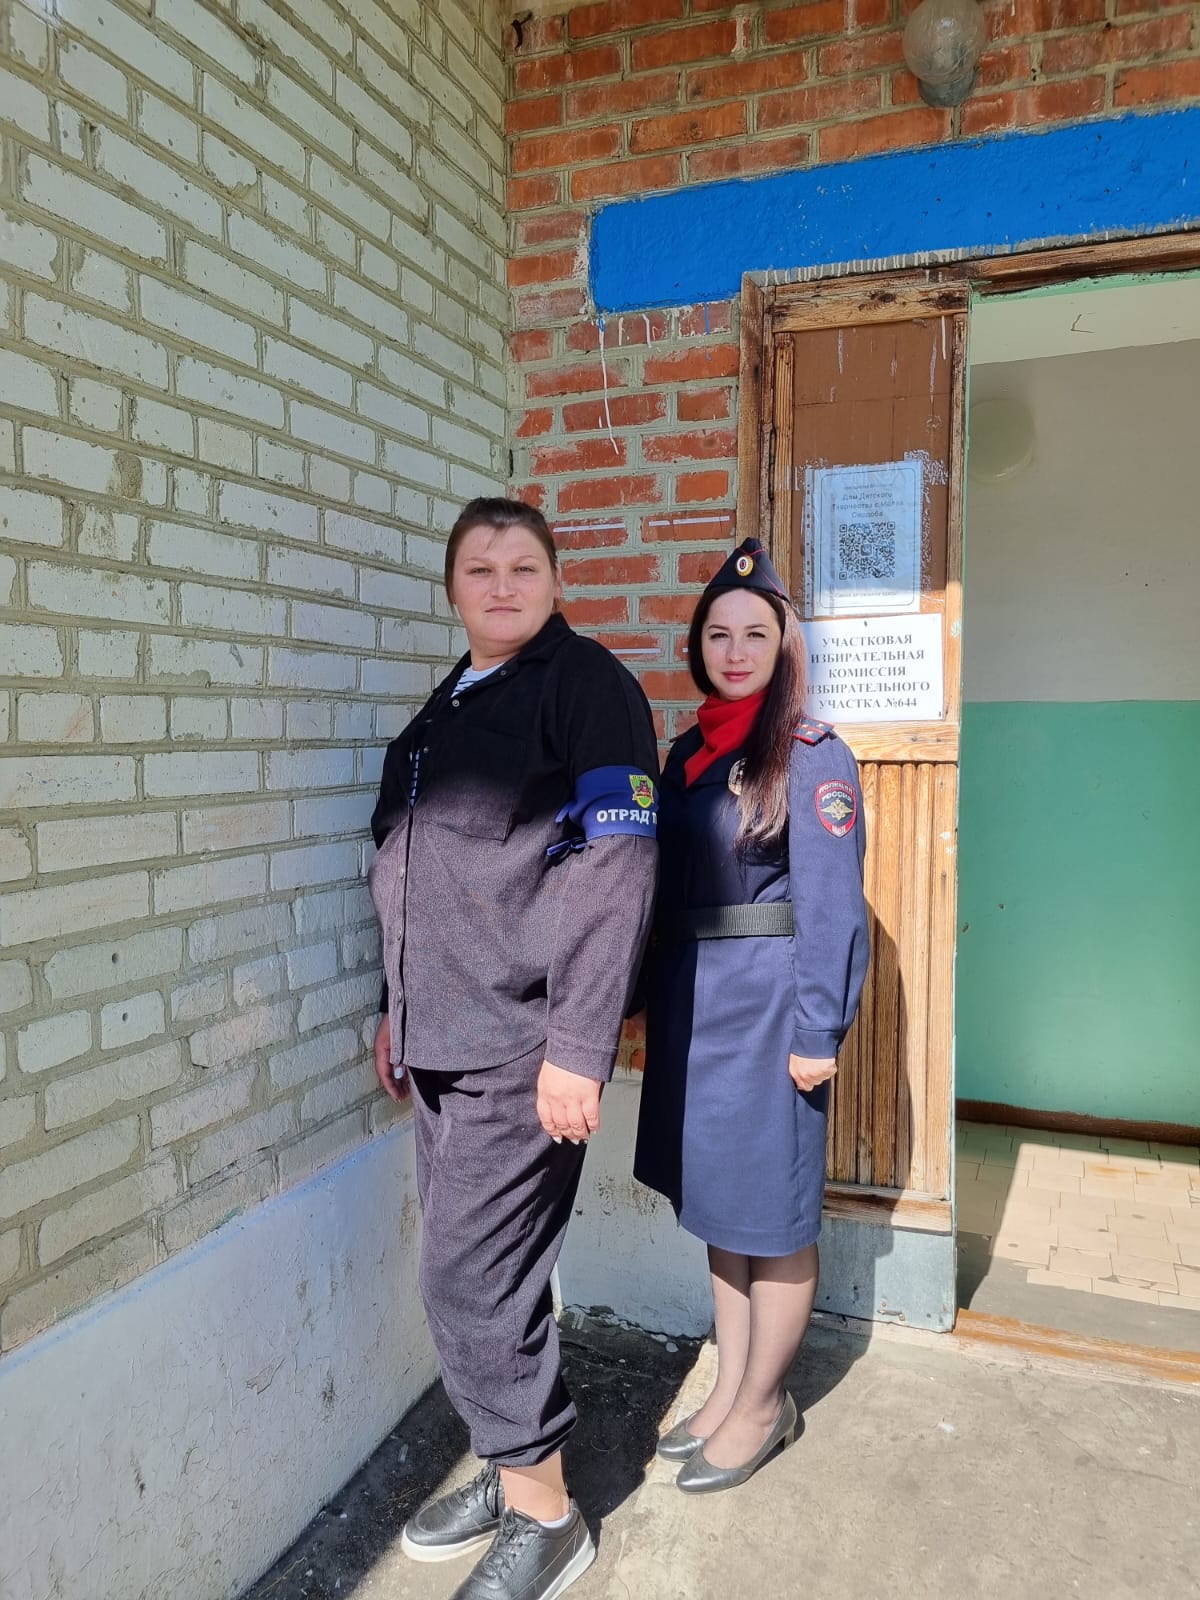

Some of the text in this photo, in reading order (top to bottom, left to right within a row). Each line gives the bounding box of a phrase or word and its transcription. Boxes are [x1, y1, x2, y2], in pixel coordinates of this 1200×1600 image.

[822, 634, 912, 648] УЧАСТКОВАЯ
[811, 650, 924, 663] ИЗБИРАТЕЛЬНАЯ
[828, 666, 906, 679] КОМИССИЯ
[807, 681, 930, 695] ИЗБИРАТЕЛЬНОГО
[819, 697, 917, 709] УЧАСТКА №644
[597, 809, 649, 825] ОТРЯД
